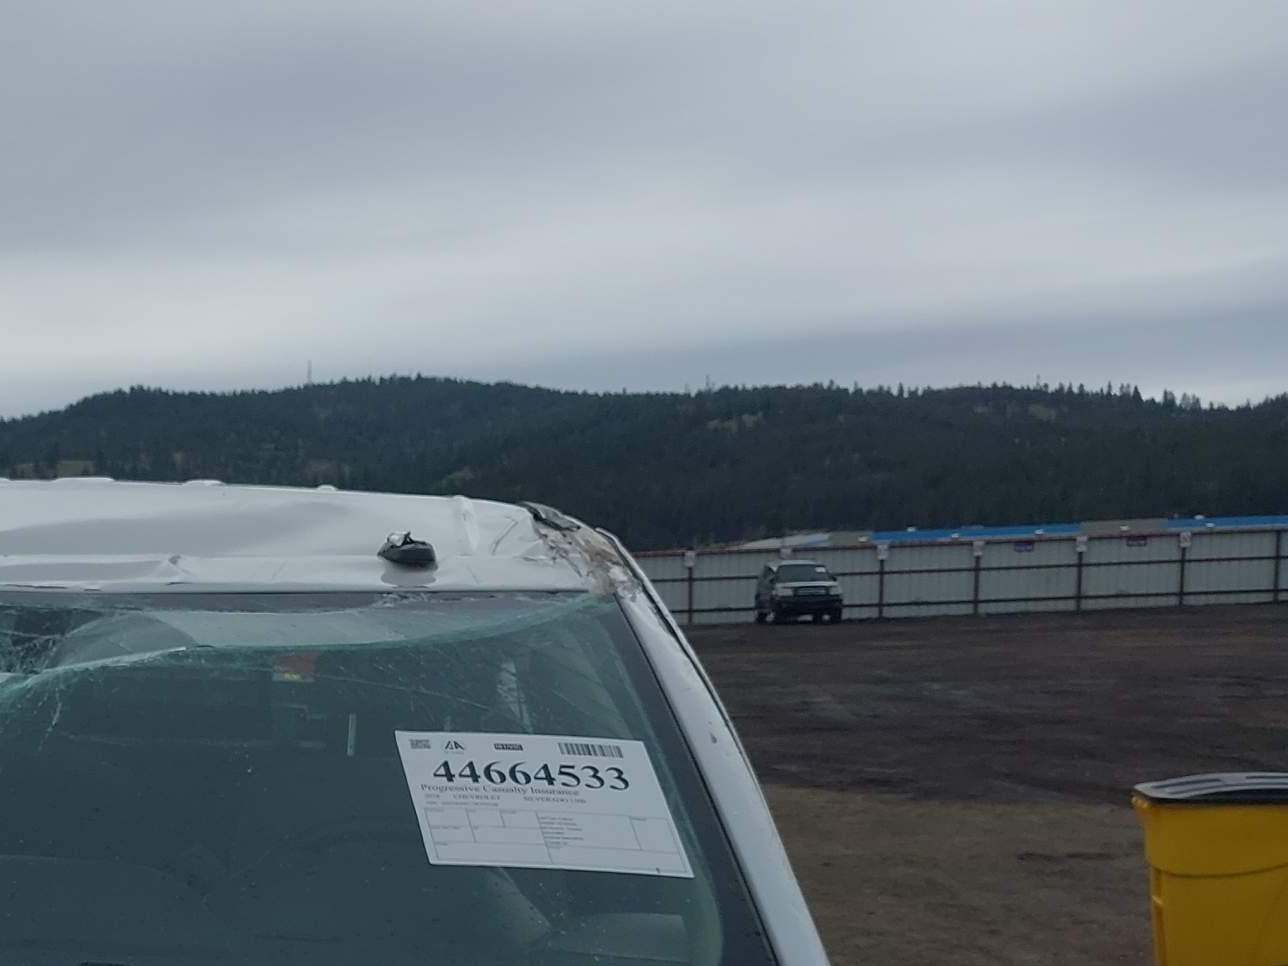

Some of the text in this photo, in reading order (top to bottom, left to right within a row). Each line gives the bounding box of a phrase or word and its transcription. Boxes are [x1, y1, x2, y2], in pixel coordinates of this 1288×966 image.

[433, 759, 631, 792] 44664533
[420, 783, 580, 797] Progressive Casualty Insurance
